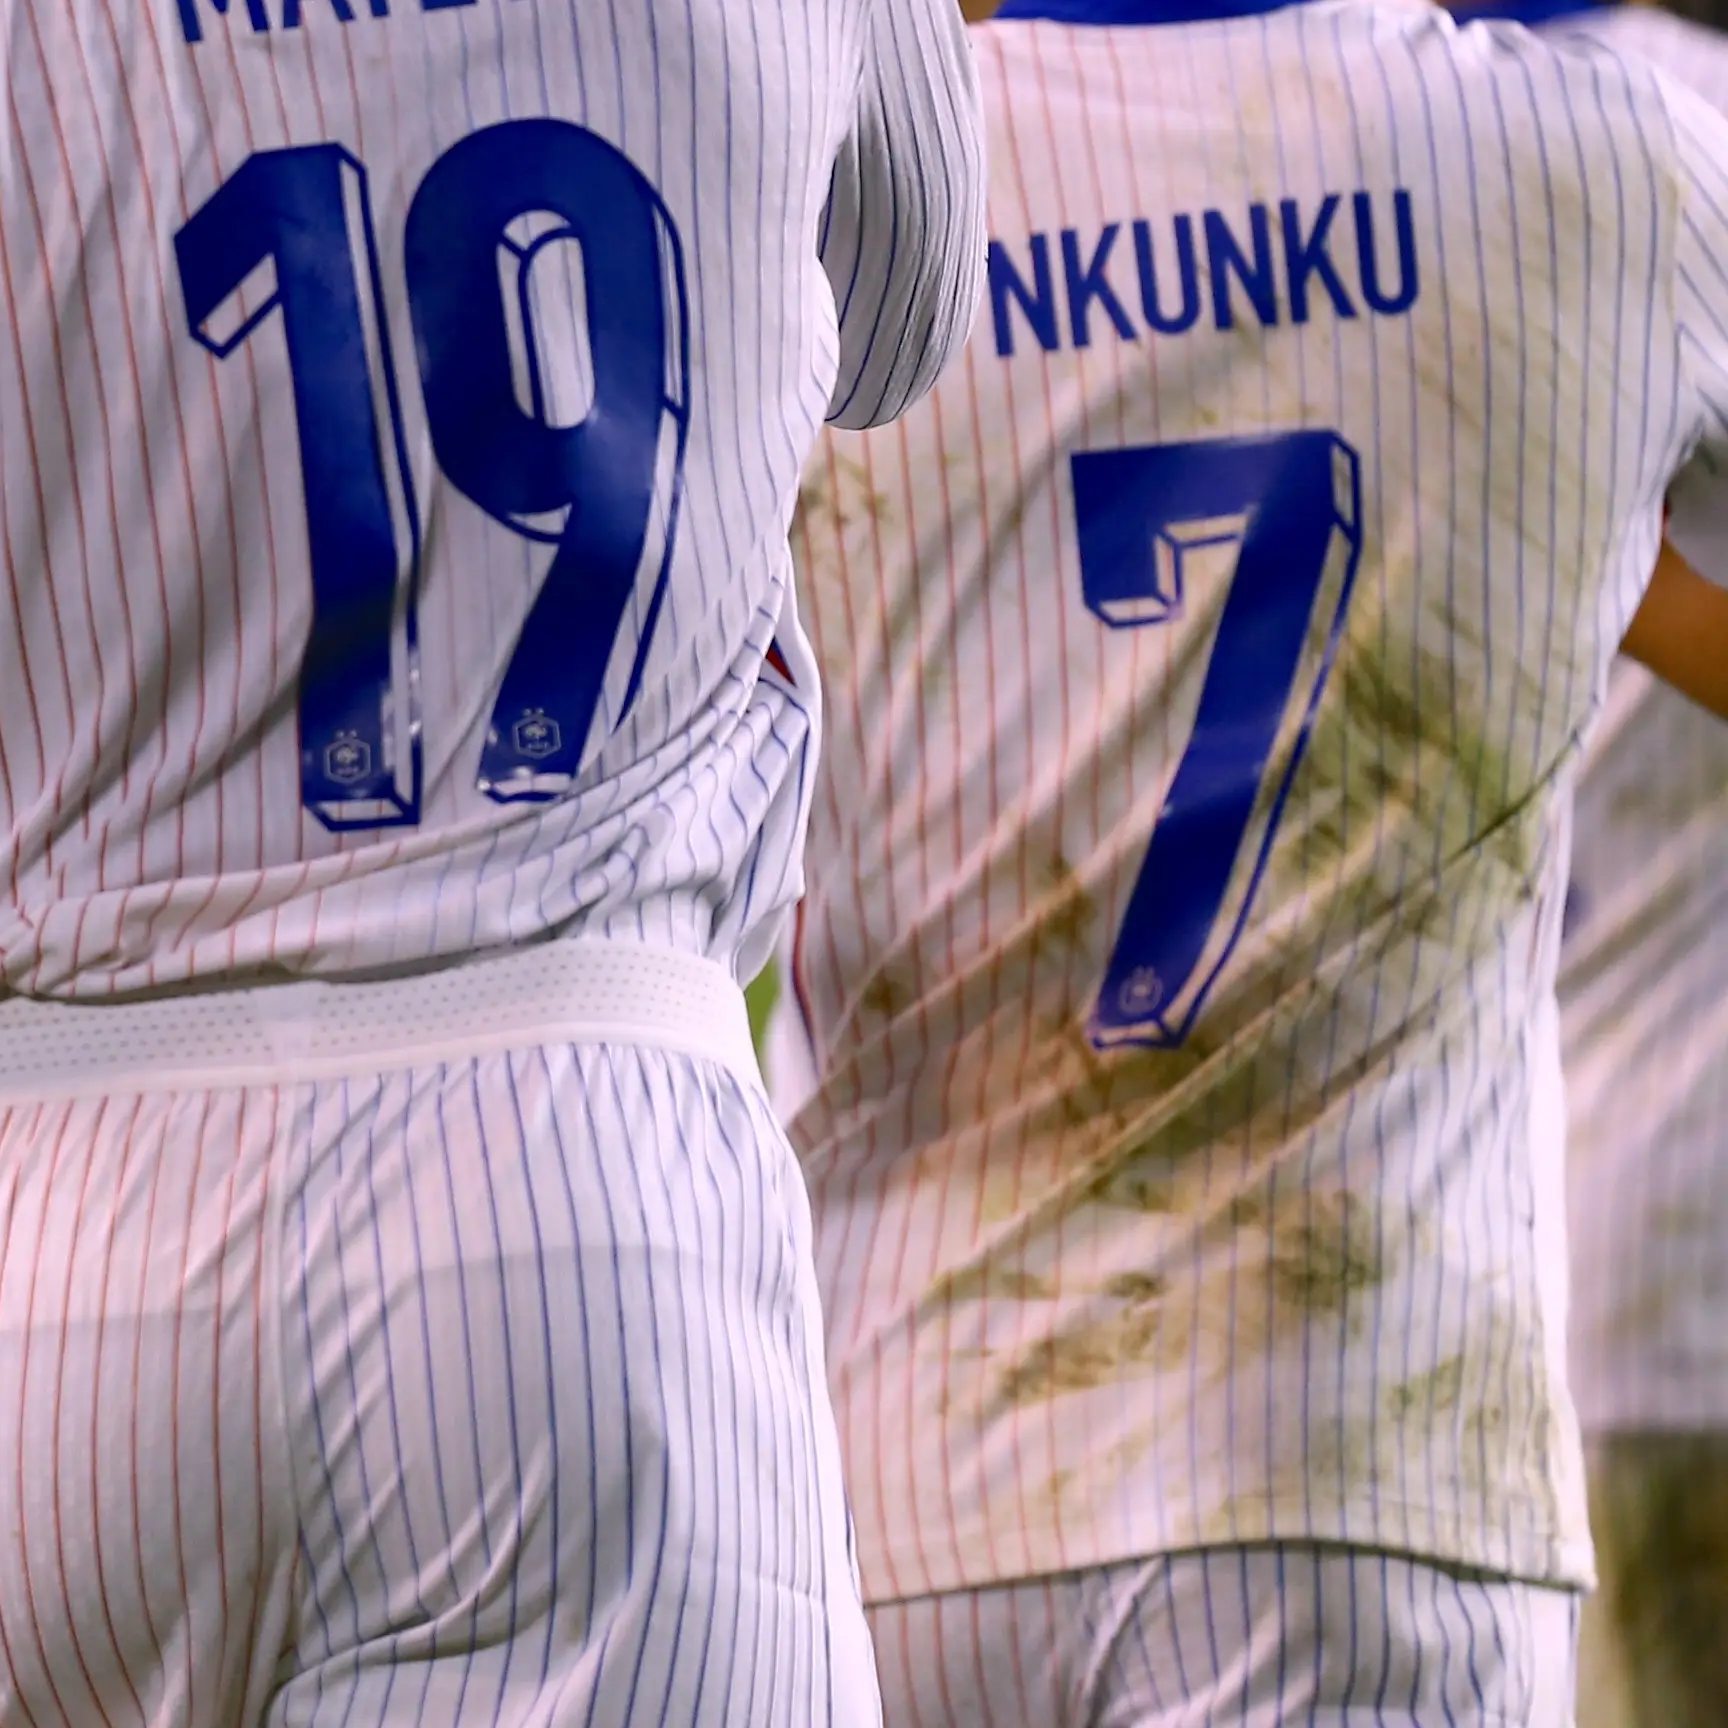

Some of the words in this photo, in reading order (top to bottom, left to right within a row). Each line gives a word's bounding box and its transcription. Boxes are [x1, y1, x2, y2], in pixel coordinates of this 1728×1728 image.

[174, 117, 690, 832] 19
[987, 189, 1418, 358] NKUNKU
[1071, 428, 1362, 1050] 7
